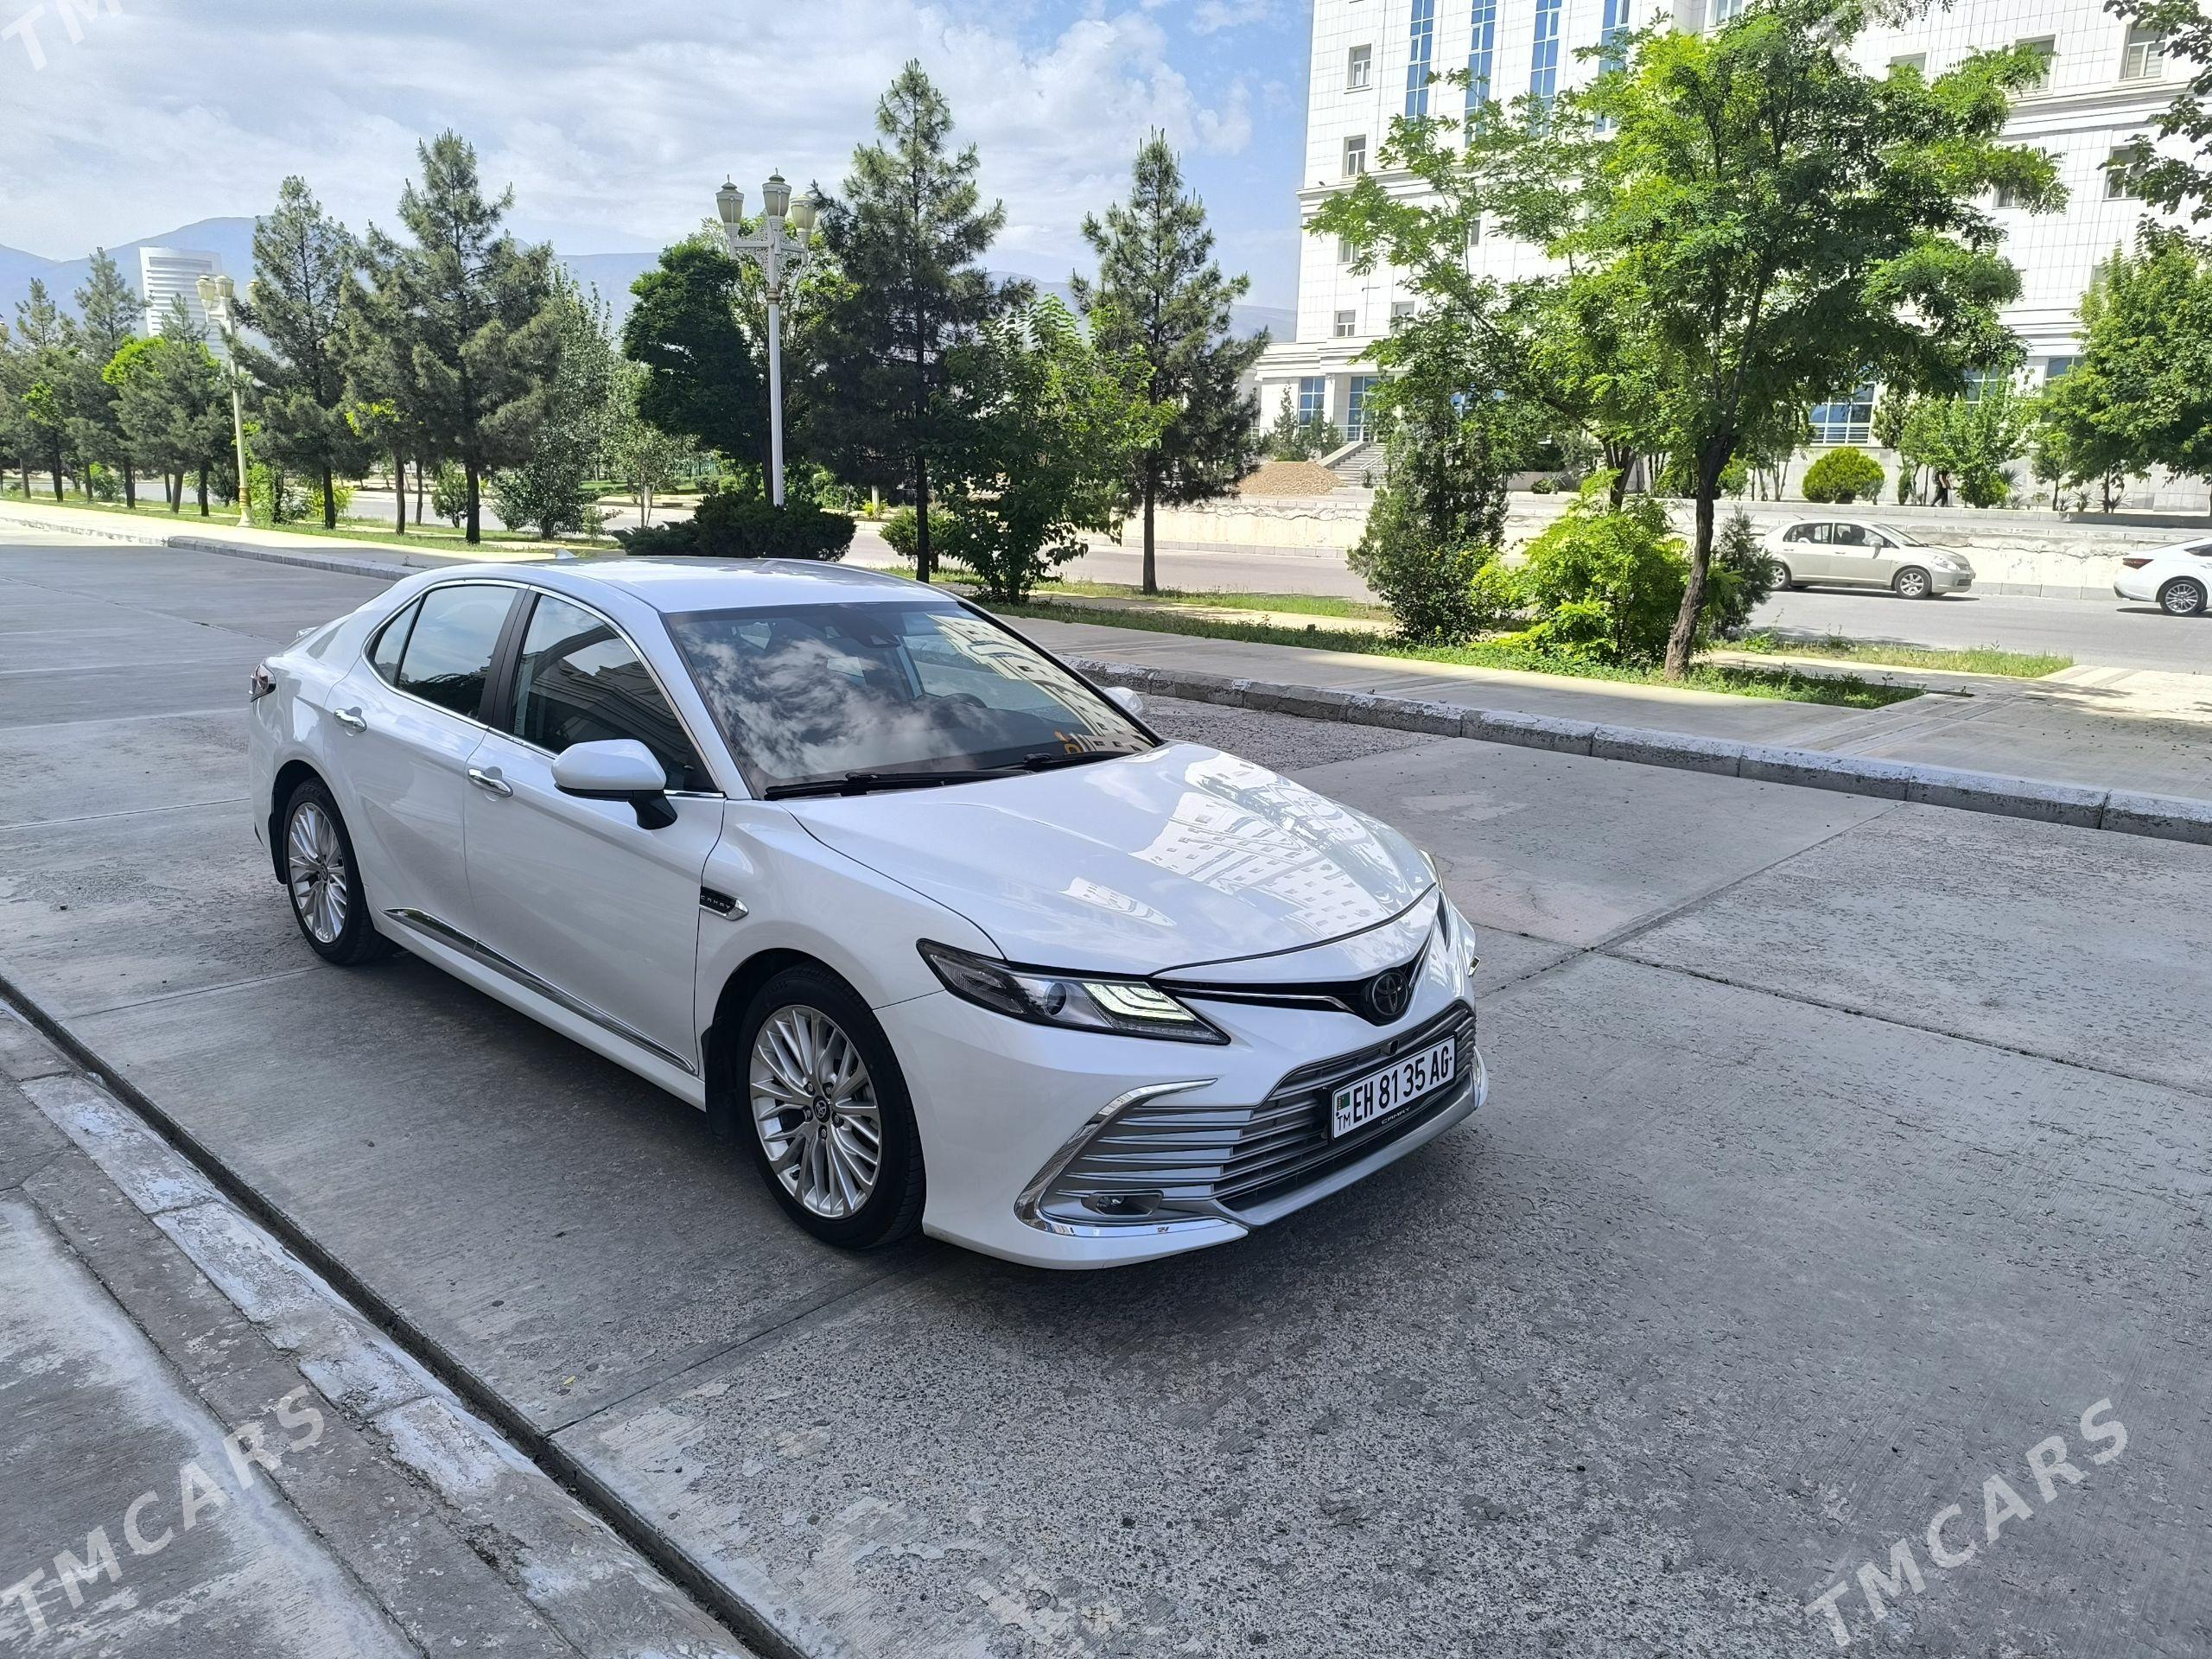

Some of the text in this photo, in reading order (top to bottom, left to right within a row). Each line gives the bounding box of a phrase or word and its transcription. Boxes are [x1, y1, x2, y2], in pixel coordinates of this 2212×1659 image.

[700, 895, 731, 910] CAMRY
[1353, 1081, 1374, 1124] EH
[1429, 1046, 1450, 1085] AG
[1336, 1111, 1351, 1132] TM
